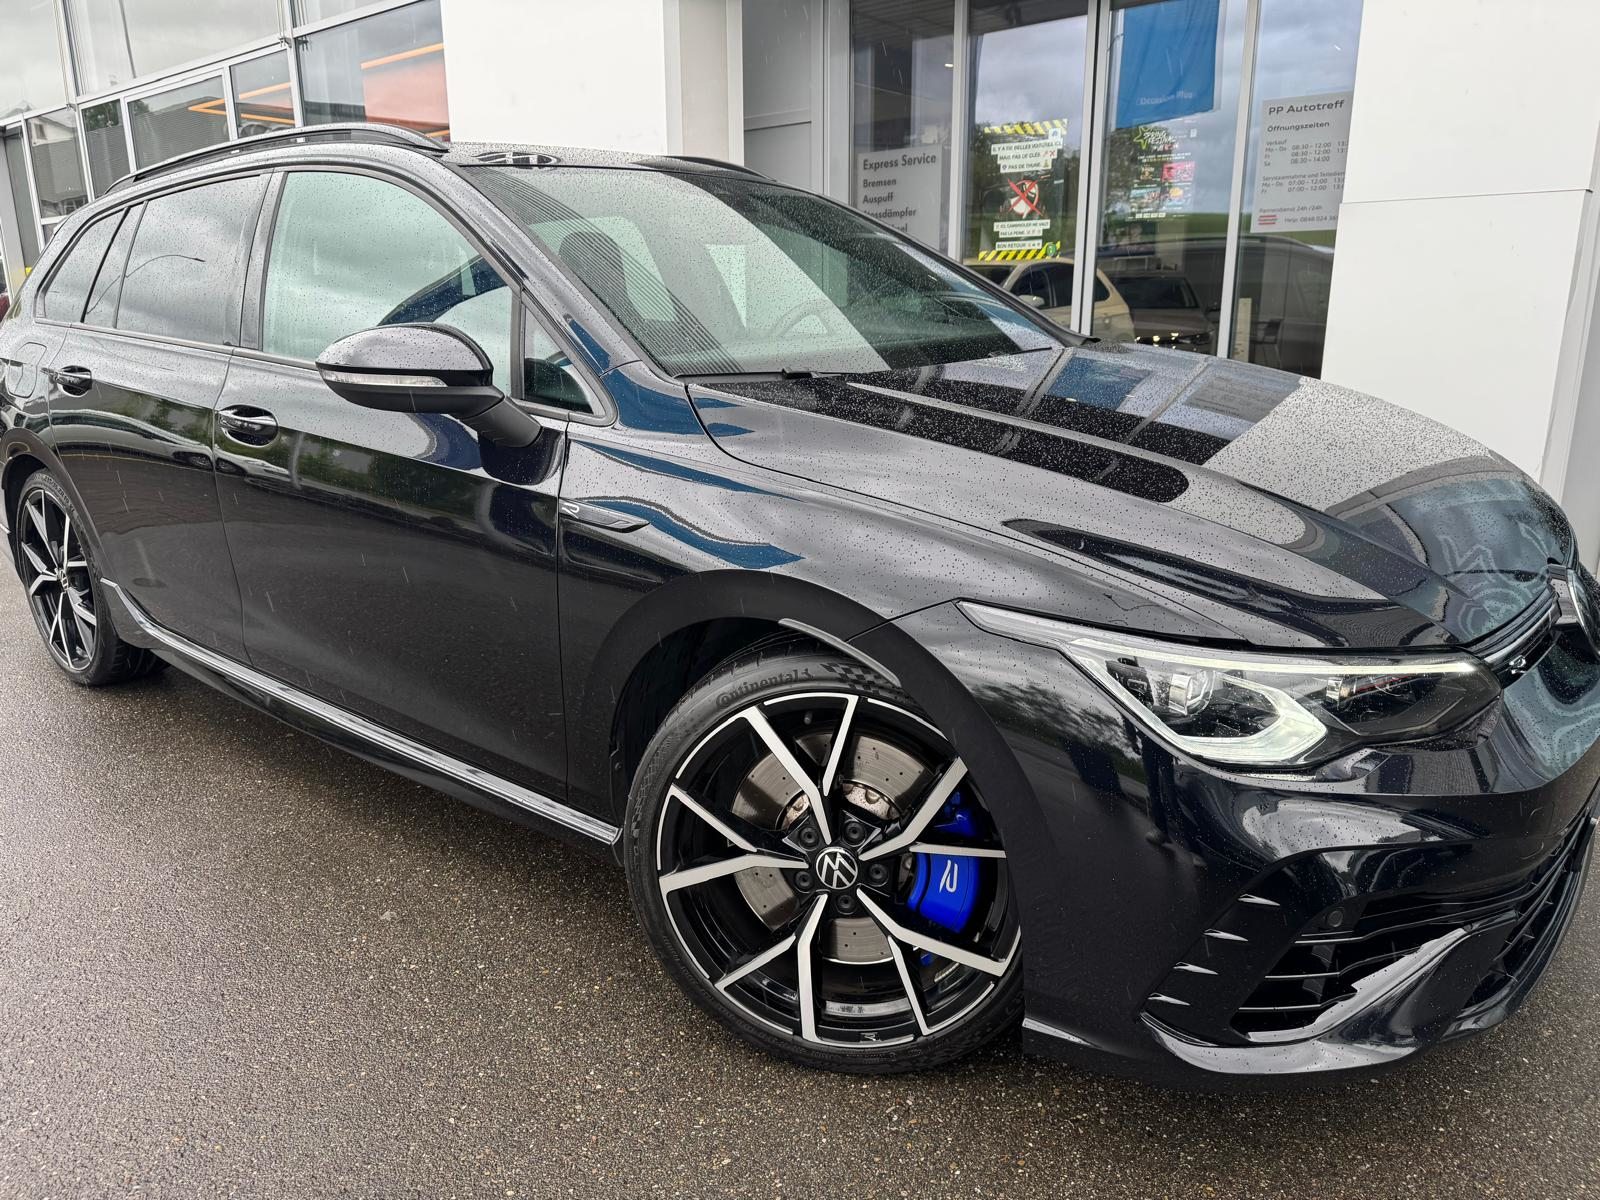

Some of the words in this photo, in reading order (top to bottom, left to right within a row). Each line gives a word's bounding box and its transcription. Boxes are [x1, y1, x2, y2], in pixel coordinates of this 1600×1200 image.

[1268, 106, 1284, 115] PP
[1286, 100, 1345, 113] Autotreff
[1267, 122, 1330, 132] Öffnungszeiten
[863, 159, 899, 172] Express
[901, 153, 937, 167] Service
[863, 179, 897, 189] Bremsen
[863, 191, 894, 205] Auspuff
